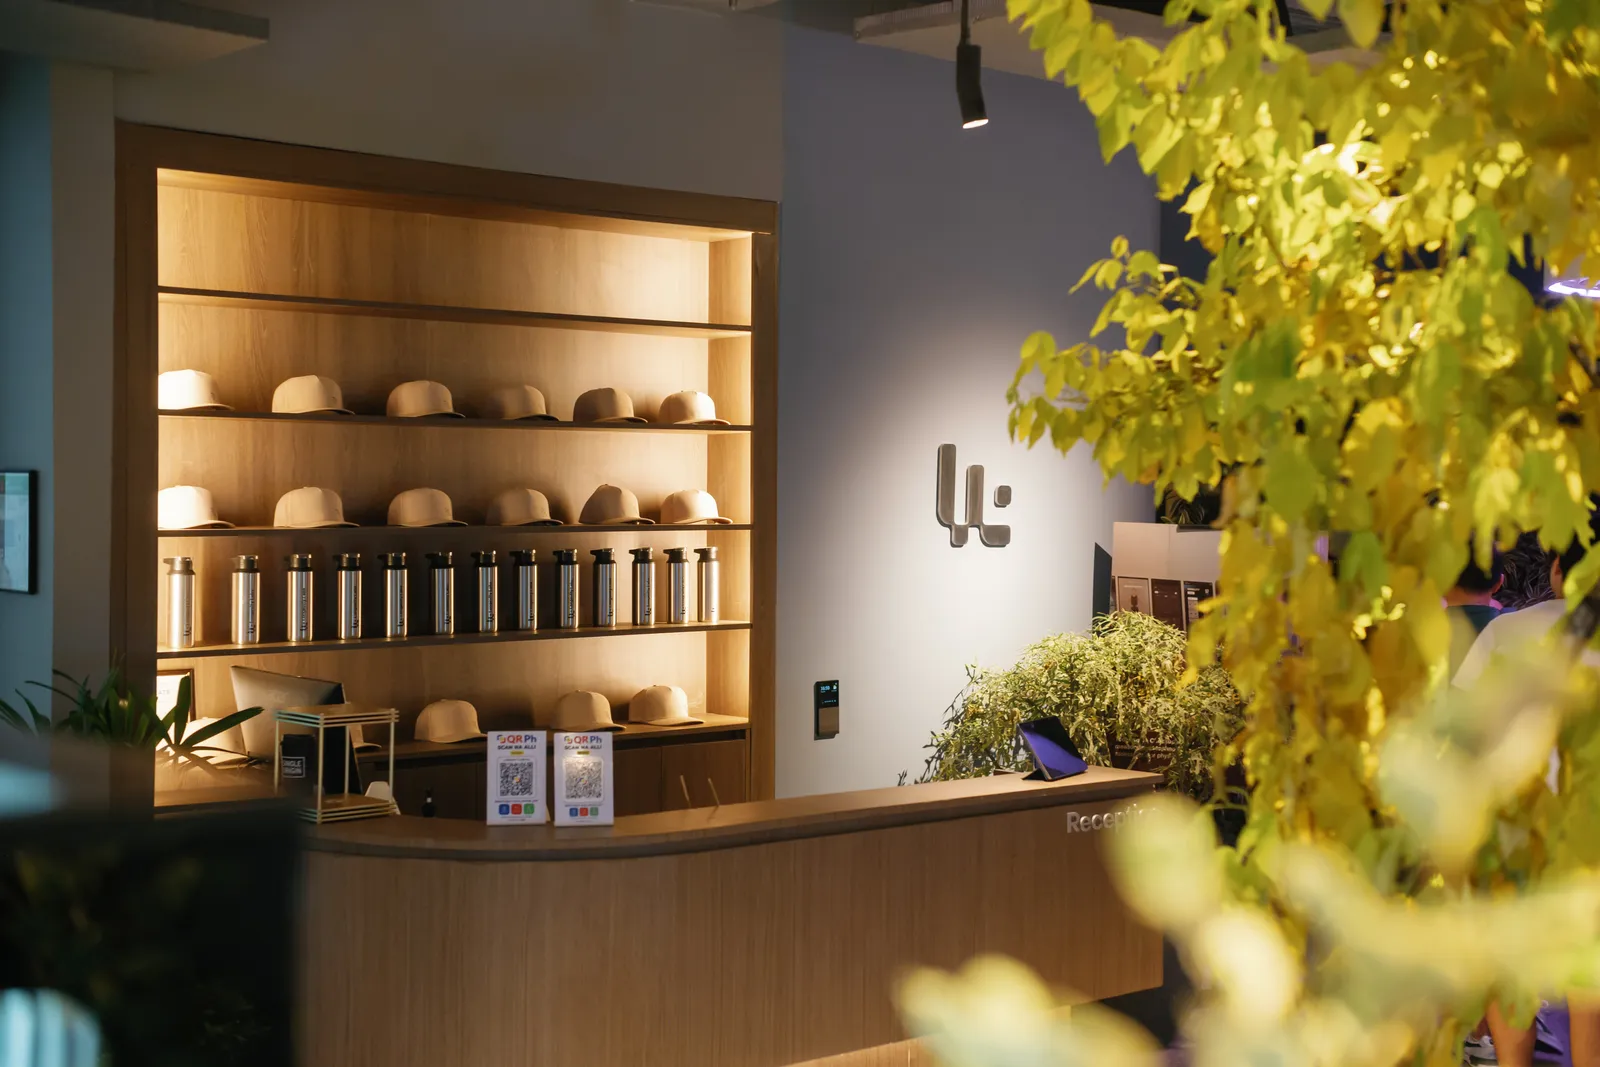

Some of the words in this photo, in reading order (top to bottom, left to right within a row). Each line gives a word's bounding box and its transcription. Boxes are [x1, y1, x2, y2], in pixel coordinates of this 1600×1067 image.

[507, 734, 523, 744] QR
[524, 734, 537, 743] Ph
[574, 735, 588, 744] QR
[590, 735, 602, 744] Ph
